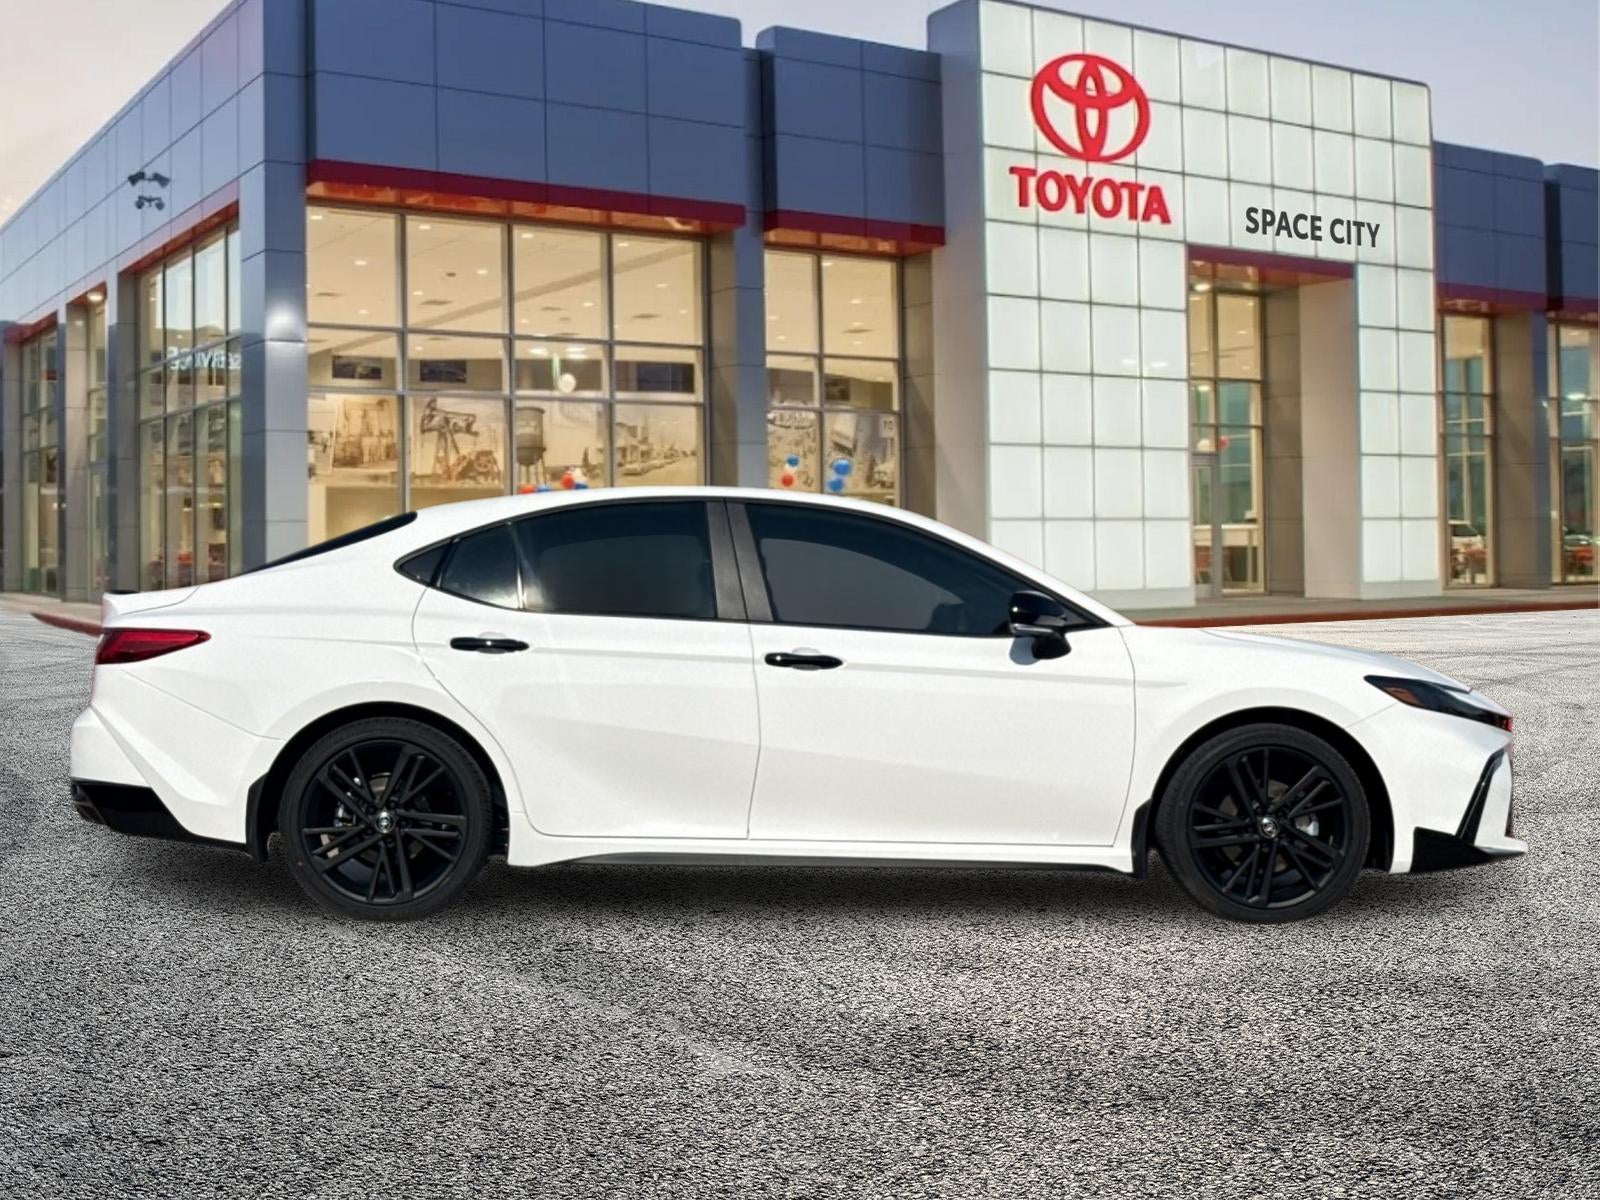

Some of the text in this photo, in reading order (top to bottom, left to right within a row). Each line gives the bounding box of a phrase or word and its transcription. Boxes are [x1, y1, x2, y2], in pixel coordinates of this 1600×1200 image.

[1009, 167, 1171, 224] TOYOTA
[1245, 206, 1380, 247] SPACE CITY
